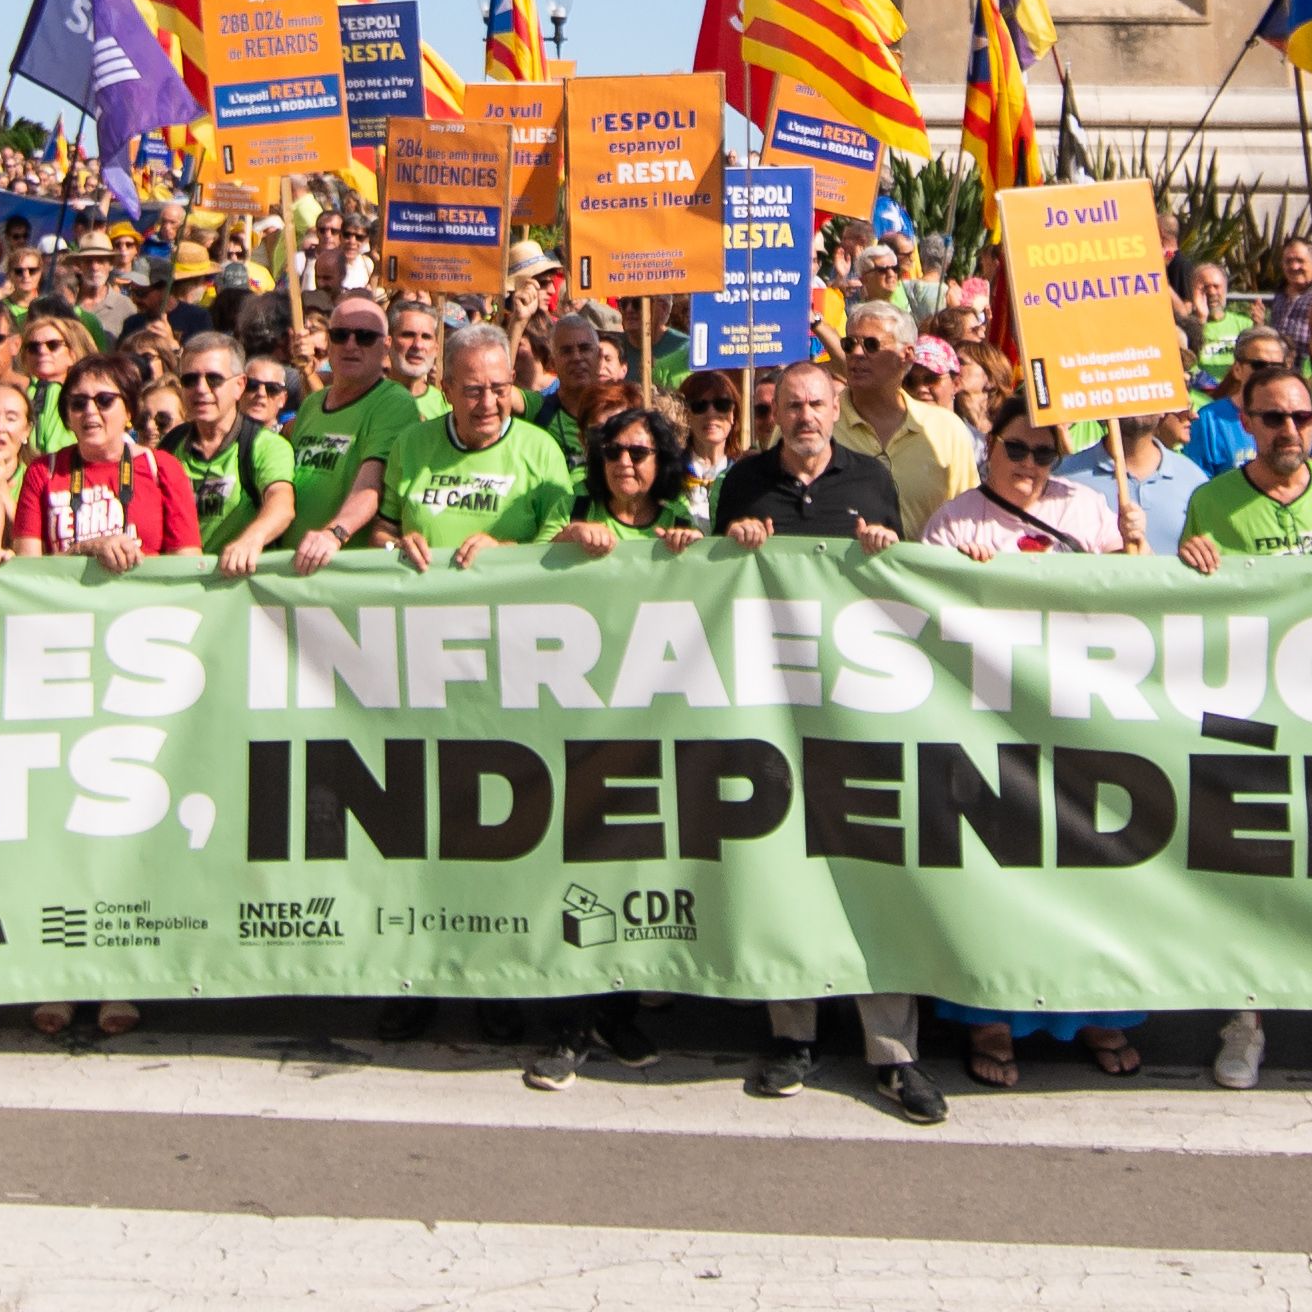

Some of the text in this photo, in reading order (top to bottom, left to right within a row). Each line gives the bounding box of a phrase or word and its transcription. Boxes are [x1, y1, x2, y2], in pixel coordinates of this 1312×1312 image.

[220, 9, 284, 35] 288.026
[340, 14, 401, 32] 'ESPOLI
[349, 30, 399, 41] ESPANYOL
[244, 32, 318, 59] RETARDS
[229, 79, 326, 104] L'espoli RESTA
[280, 96, 337, 111] RODALIES
[485, 102, 543, 118] Jo vull
[591, 109, 696, 133] l'ESPOLI
[512, 128, 558, 144] ALIES
[788, 120, 868, 148] L'espoli RESTA
[397, 138, 424, 158] 284
[608, 136, 681, 155] espanyol
[828, 142, 875, 162] RODALIES
[515, 151, 552, 166] litat
[396, 161, 498, 188] INCIDÈNCIES
[597, 160, 695, 184] et RESTA
[580, 191, 712, 210] descans i lleure
[724, 185, 792, 205] 'ESPOLI
[401, 208, 487, 224] L'espoli RESTA
[1045, 199, 1118, 227] Jo vull
[445, 224, 496, 237] RODALIES
[1028, 234, 1147, 268] RODALIES
[609, 268, 686, 282] NO HO DUBTIS
[773, 286, 790, 301] dia
[1024, 272, 1161, 308] de QUALITAT
[1077, 346, 1162, 367] independència
[1096, 369, 1108, 382] la
[1108, 364, 1150, 381] solució
[1061, 382, 1175, 409] NO HO DUBTIS
[430, 474, 462, 486] FEM
[422, 488, 441, 505] EL
[94, 900, 151, 914] Consell
[240, 902, 303, 920] INTER
[622, 888, 697, 926] CDR
[94, 916, 208, 932] de la República
[240, 920, 344, 938] SINDICAL
[94, 934, 161, 947] Catalana
[624, 925, 697, 942] CATALUNYA
